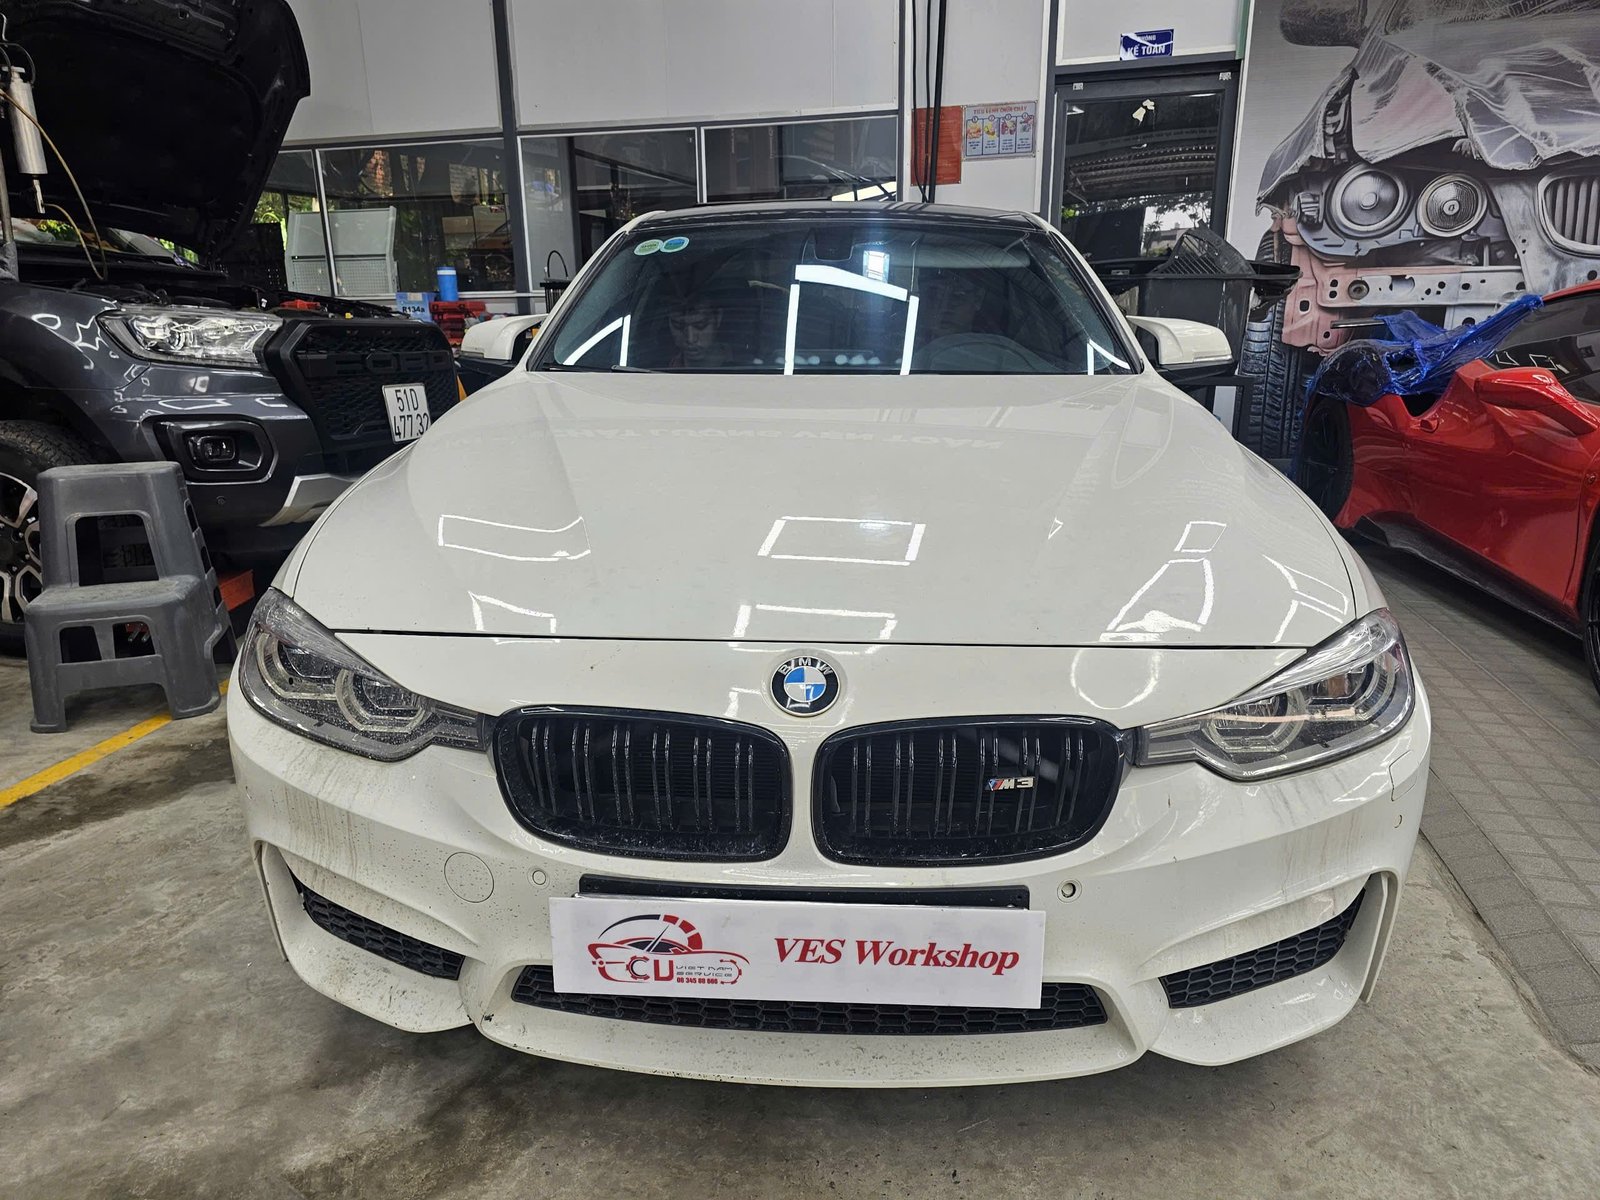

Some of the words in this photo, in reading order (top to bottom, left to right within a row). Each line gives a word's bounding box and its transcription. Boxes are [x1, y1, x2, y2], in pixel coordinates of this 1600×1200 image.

[402, 306, 425, 314] R134a
[395, 388, 419, 413] 51D
[778, 656, 833, 676] BMW
[990, 777, 1035, 790] M3
[774, 937, 845, 964] VES
[855, 940, 1020, 976] Workshop
